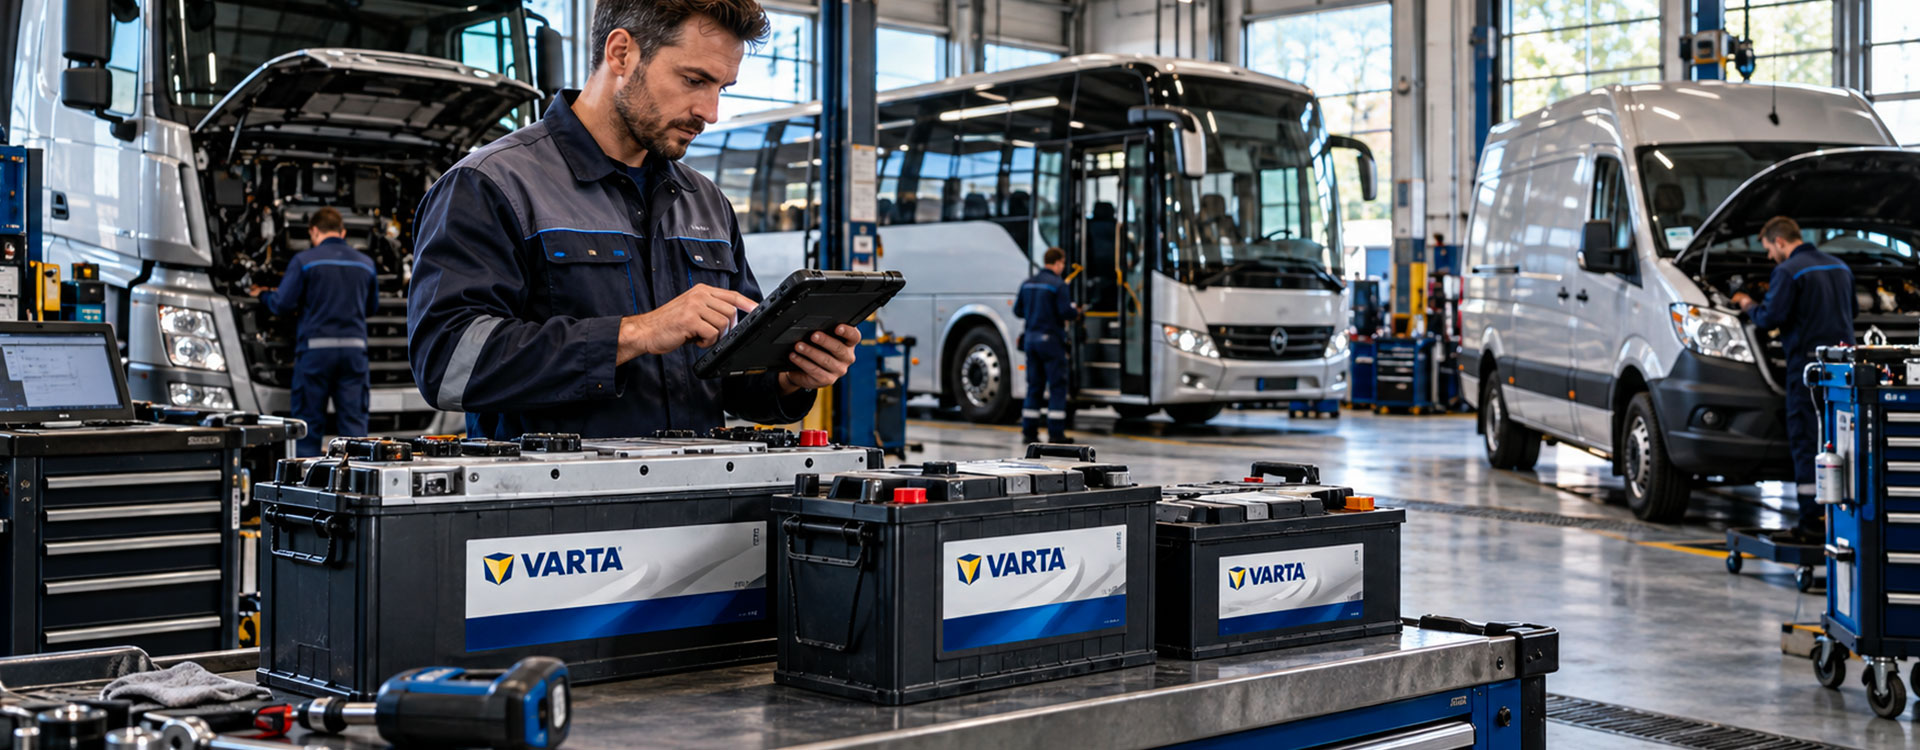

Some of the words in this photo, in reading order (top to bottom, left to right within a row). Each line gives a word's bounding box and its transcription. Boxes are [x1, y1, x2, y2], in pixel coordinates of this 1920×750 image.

[521, 546, 623, 578] VARTA
[986, 547, 1066, 578] VARTA
[1249, 562, 1305, 585] VARTA
